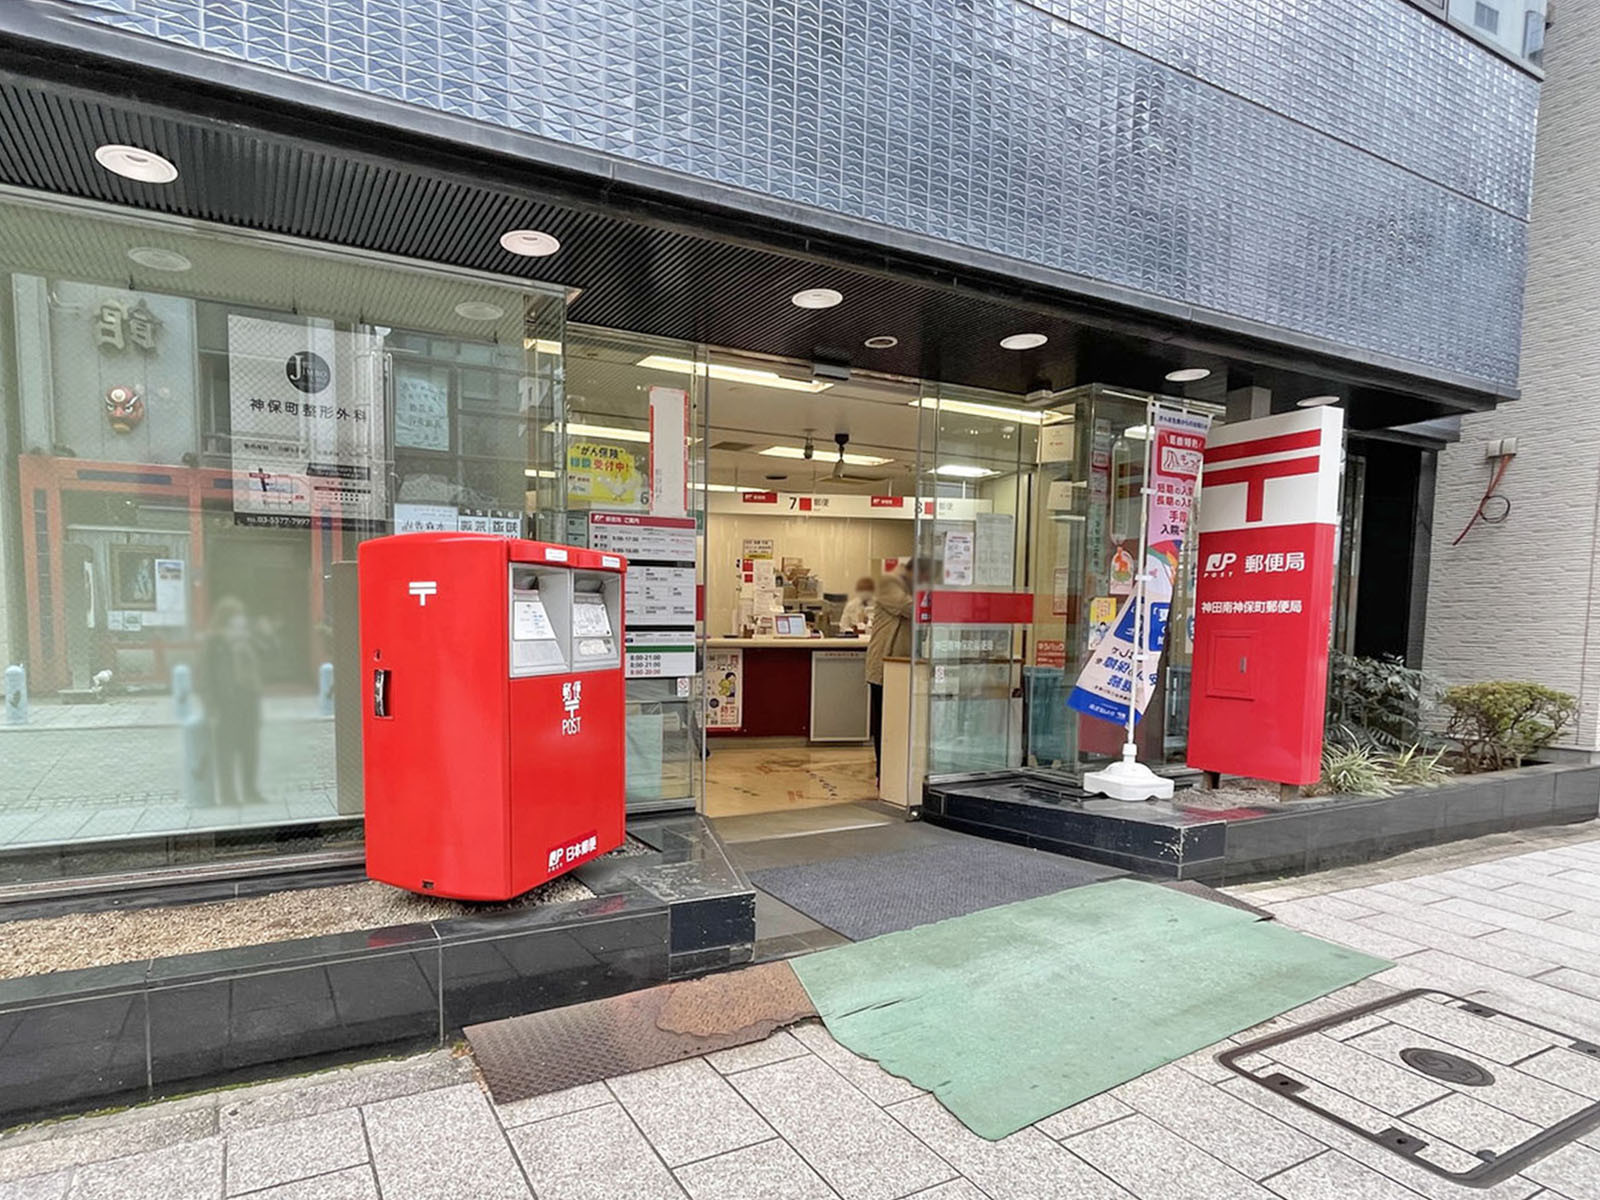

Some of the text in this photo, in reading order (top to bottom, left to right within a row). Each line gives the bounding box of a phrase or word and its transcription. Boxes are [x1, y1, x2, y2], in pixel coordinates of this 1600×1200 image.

[250, 398, 367, 423] 神保町整形外科
[640, 491, 649, 505] 6
[789, 496, 797, 510] 7
[1244, 552, 1305, 573] 郵便局
[1201, 600, 1302, 614] 神田南神保町郵便局
[562, 681, 582, 702] 郵便
[562, 716, 581, 736] POST
[566, 836, 597, 862] 日本郵便
